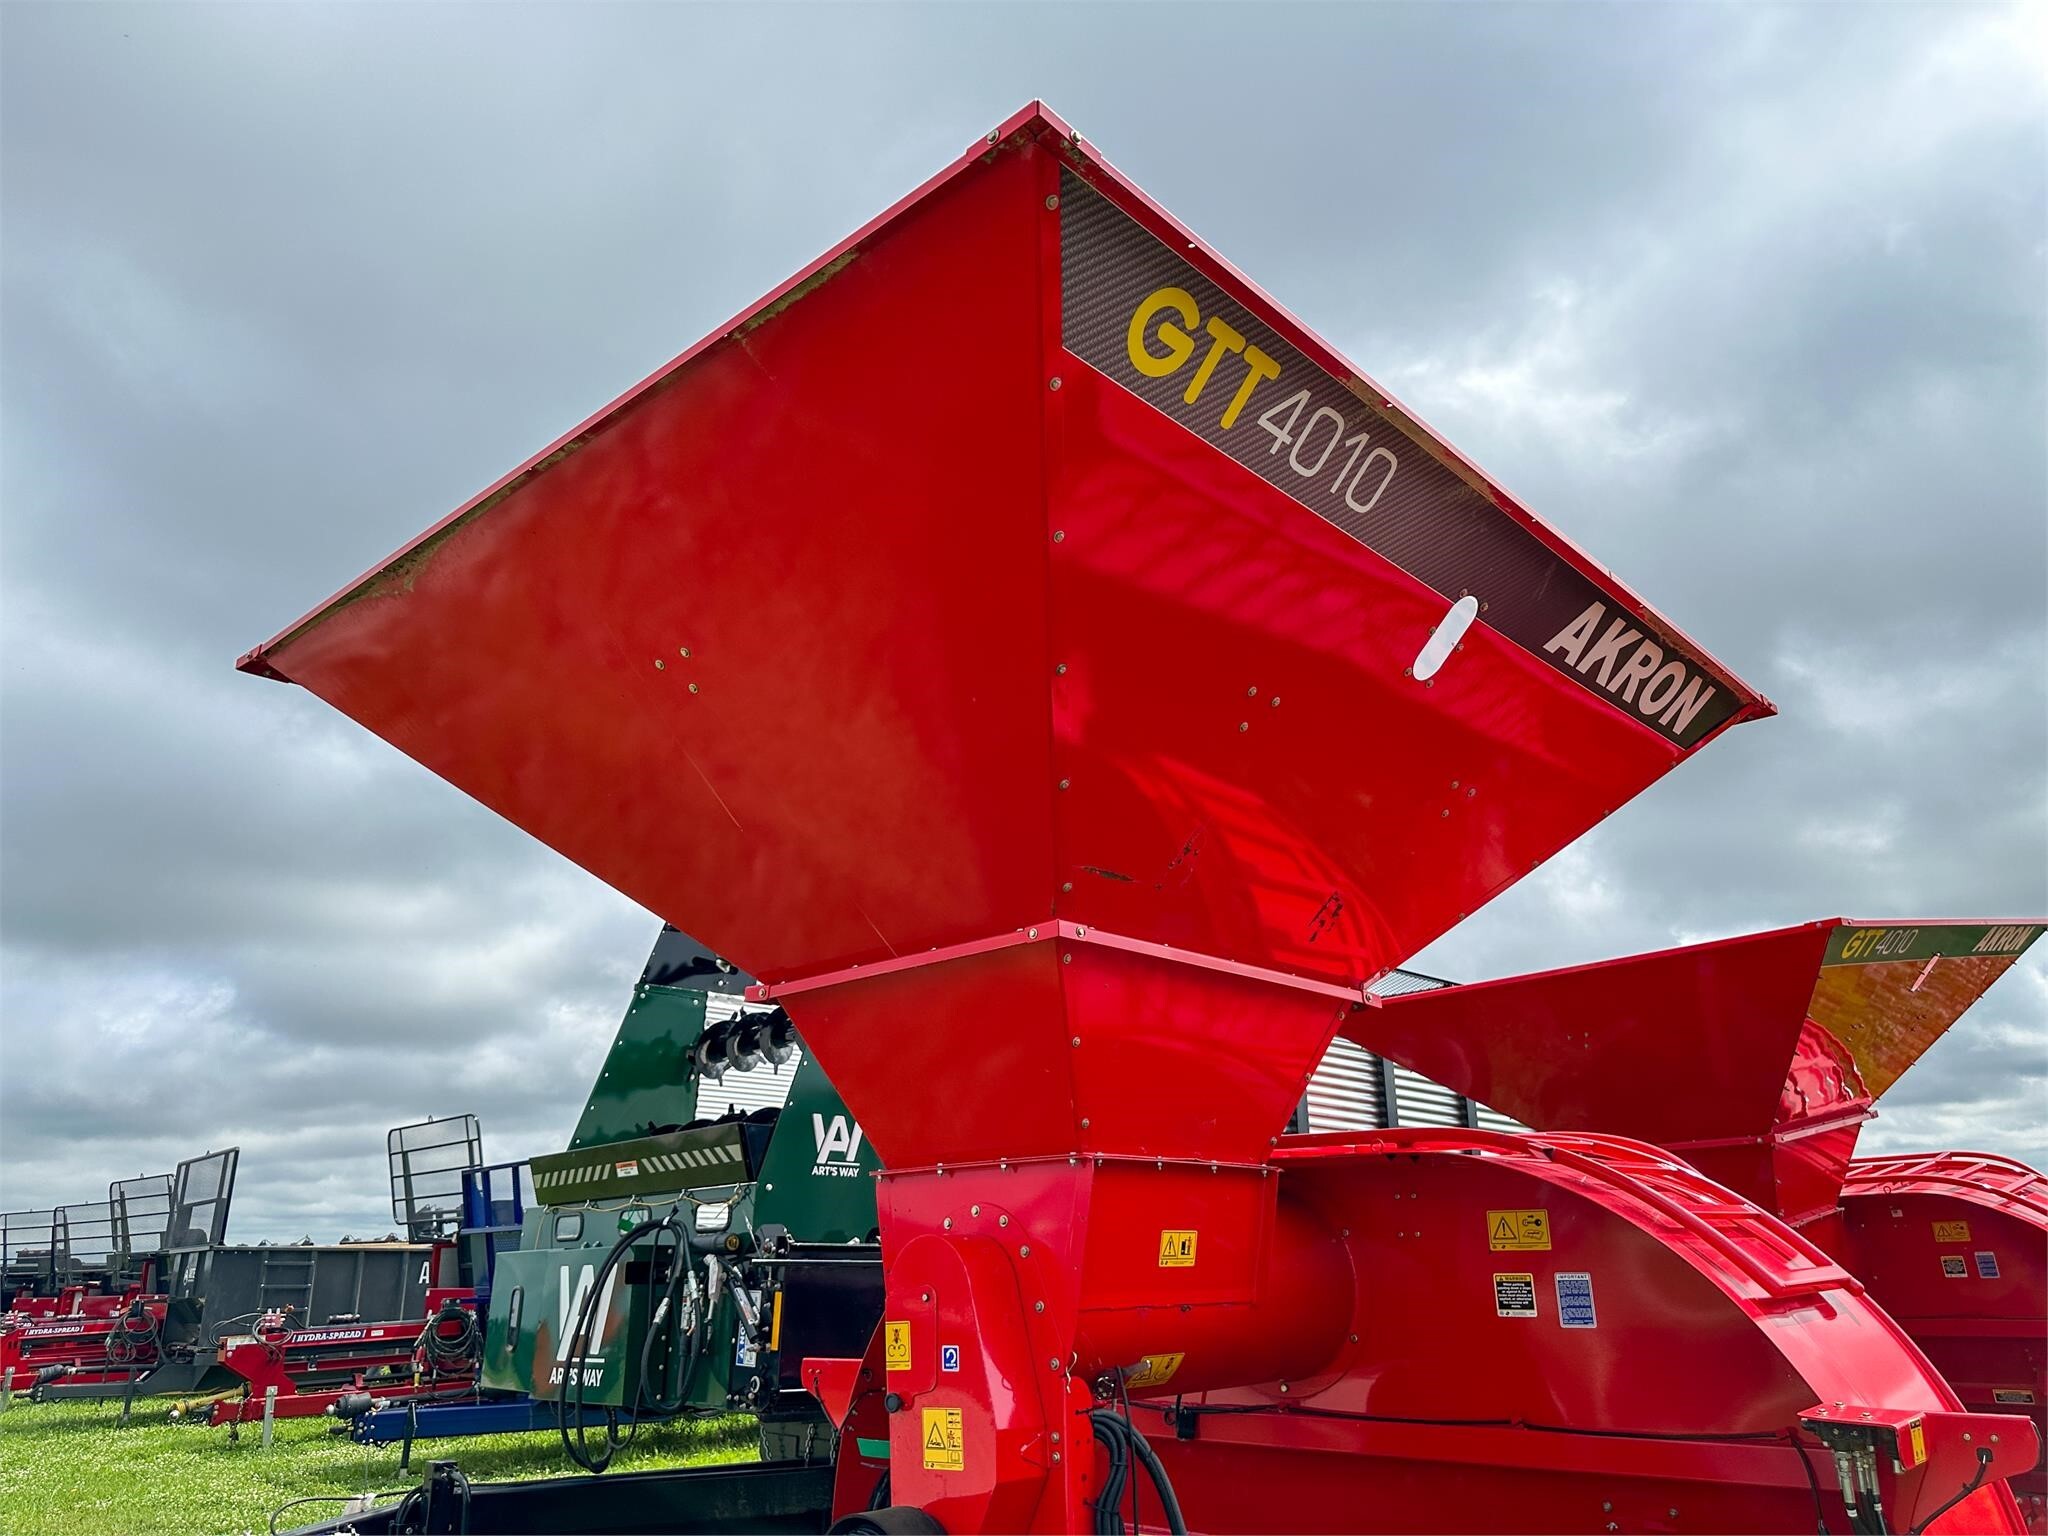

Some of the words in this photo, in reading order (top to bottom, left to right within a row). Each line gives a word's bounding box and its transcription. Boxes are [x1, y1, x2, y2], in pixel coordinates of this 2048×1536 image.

[1542, 600, 1717, 736] AKRON
[1972, 925, 2037, 952] AKRON
[811, 1166, 838, 1177] ART'S
[839, 1167, 860, 1178] WAY
[548, 1366, 579, 1386] AR'S
